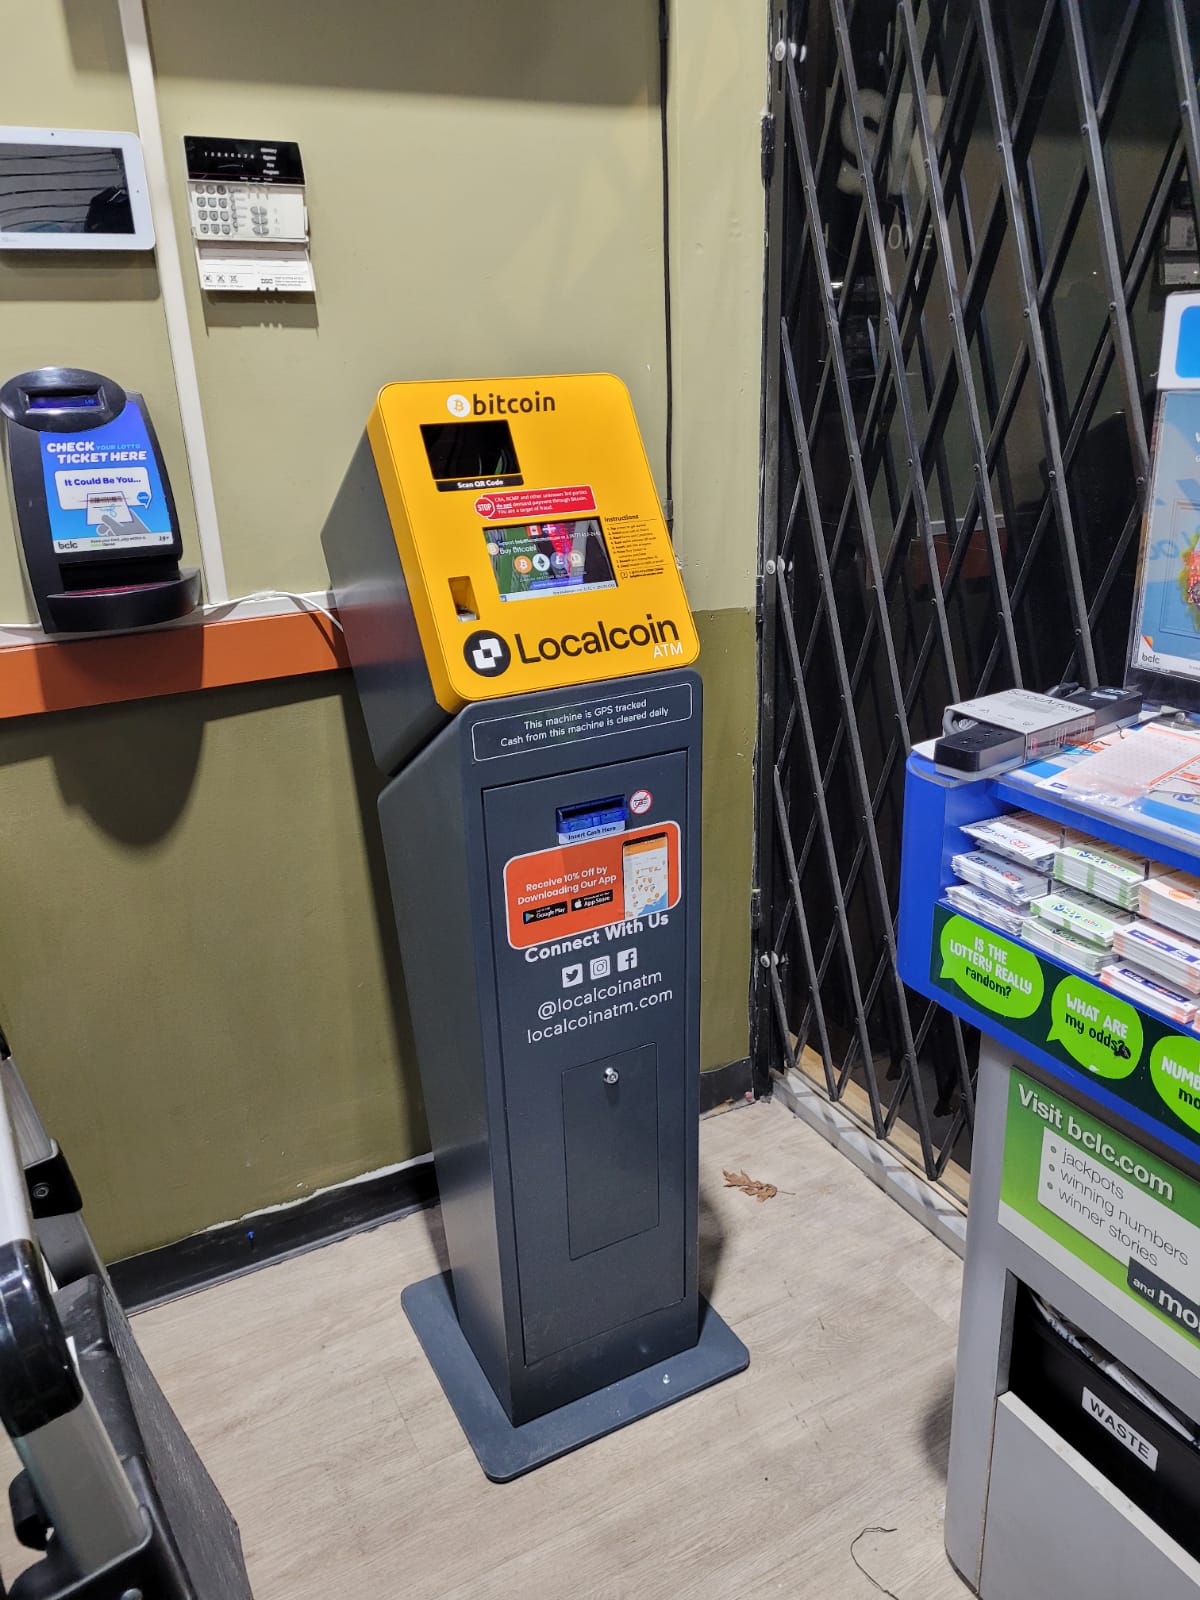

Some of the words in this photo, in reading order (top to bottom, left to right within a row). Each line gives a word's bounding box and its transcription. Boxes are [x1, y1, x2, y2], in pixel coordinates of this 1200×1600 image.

[472, 390, 556, 416] bitcoin
[46, 441, 95, 453] CHECK
[57, 452, 109, 464] TICKET
[110, 450, 147, 462] HERE
[64, 479, 73, 487] It
[73, 476, 101, 486] Could
[103, 477, 115, 485] Be
[116, 476, 141, 484] You...
[457, 479, 474, 489] Scan
[474, 480, 486, 489] QR
[486, 478, 504, 487] Code
[476, 503, 492, 512] STOP
[520, 506, 534, 514] target
[533, 498, 552, 507] payment
[552, 496, 570, 505] through
[604, 514, 639, 523] Instructions
[57, 540, 79, 550] bclc
[499, 546, 512, 555] Buy
[514, 613, 680, 664] Localcoin
[652, 641, 684, 660] ATM
[1141, 652, 1161, 665] bclc
[500, 734, 523, 748] Cash
[526, 730, 547, 743] from
[549, 725, 565, 738] this
[568, 718, 604, 735] machine
[606, 716, 614, 726] is
[616, 709, 647, 724] cleared
[649, 706, 669, 722] daily
[524, 719, 543, 731] This
[545, 711, 583, 727] machine
[585, 708, 592, 719] is
[594, 704, 613, 717] GPS
[615, 699, 647, 714] tracked
[567, 830, 585, 841] Insert
[586, 828, 601, 837] Cash
[602, 825, 616, 833] Here
[517, 882, 579, 905] Downloading
[580, 878, 597, 889] Our
[598, 874, 617, 887] App
[525, 876, 562, 892] Receive
[563, 871, 580, 883] 10%
[581, 867, 595, 878] Off
[596, 866, 608, 876] by
[536, 907, 555, 920] Google
[555, 905, 566, 915] Play
[583, 899, 595, 908] App
[595, 895, 611, 905] Store
[524, 930, 600, 963] Connect
[605, 919, 644, 941] With
[648, 912, 670, 929] Us
[974, 936, 985, 953] IS
[987, 944, 1008, 965] THE
[950, 938, 993, 973] LOTTERY
[994, 964, 1033, 995] REALLY
[537, 971, 662, 1021] @localcoinatm
[965, 965, 1012, 999] random?
[527, 989, 673, 1044] localcoinatm.com
[1066, 993, 1100, 1022] WHAT
[1103, 1016, 1129, 1040] ARE
[1065, 1012, 1085, 1035] my
[1089, 1027, 1125, 1054] odds?
[1018, 1083, 1063, 1129] Visit
[1067, 1115, 1174, 1202] bclc.com
[1062, 1148, 1124, 1200] jackpots
[1058, 1189, 1106, 1229] winner
[1108, 1223, 1158, 1267] stories
[1060, 1170, 1114, 1217] winning
[1118, 1208, 1189, 1267] numbers
[1133, 1277, 1156, 1299] and
[1158, 1289, 1200, 1334] mo
[1090, 1397, 1150, 1460] WASTE
